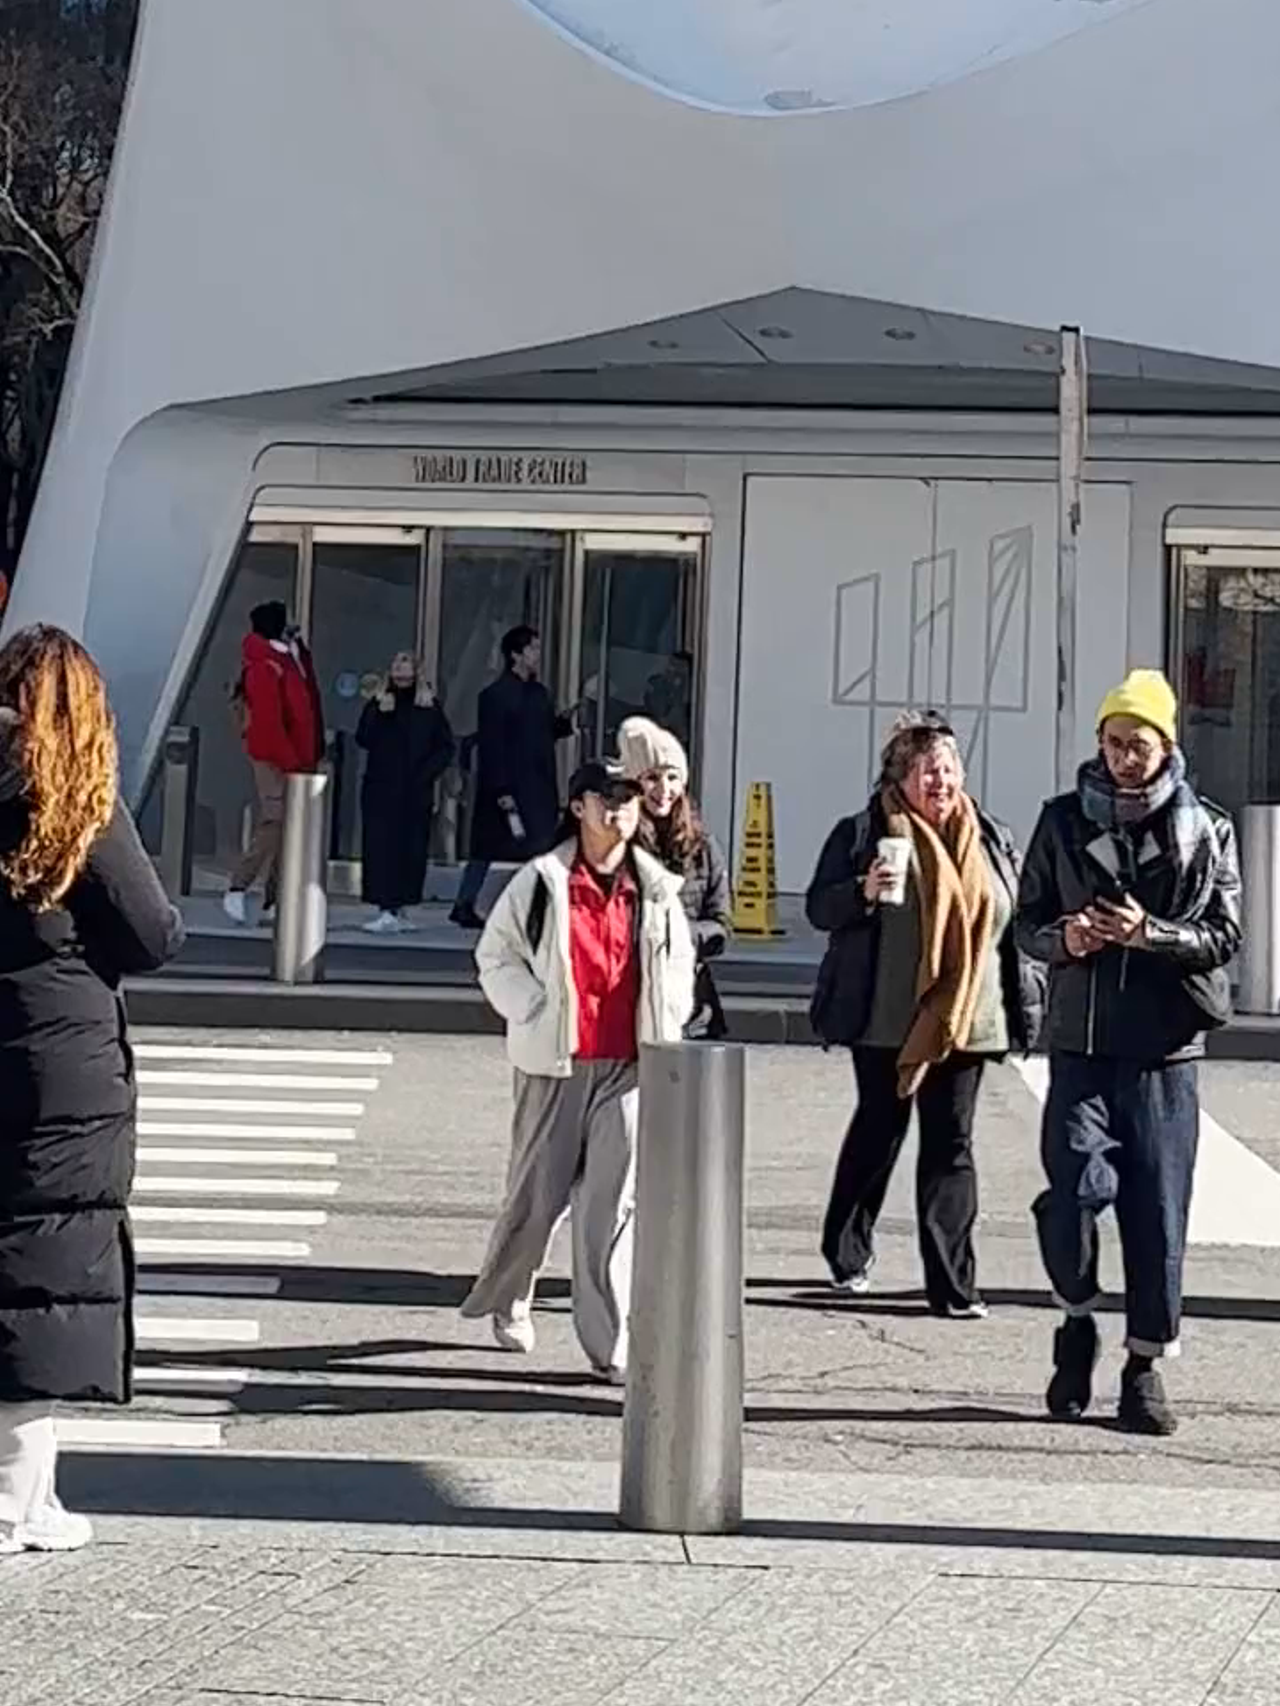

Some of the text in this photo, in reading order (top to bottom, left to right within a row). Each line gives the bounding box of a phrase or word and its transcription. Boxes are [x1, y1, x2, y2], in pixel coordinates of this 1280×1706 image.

[413, 455, 587, 484] WORLD TRADE CENTER
